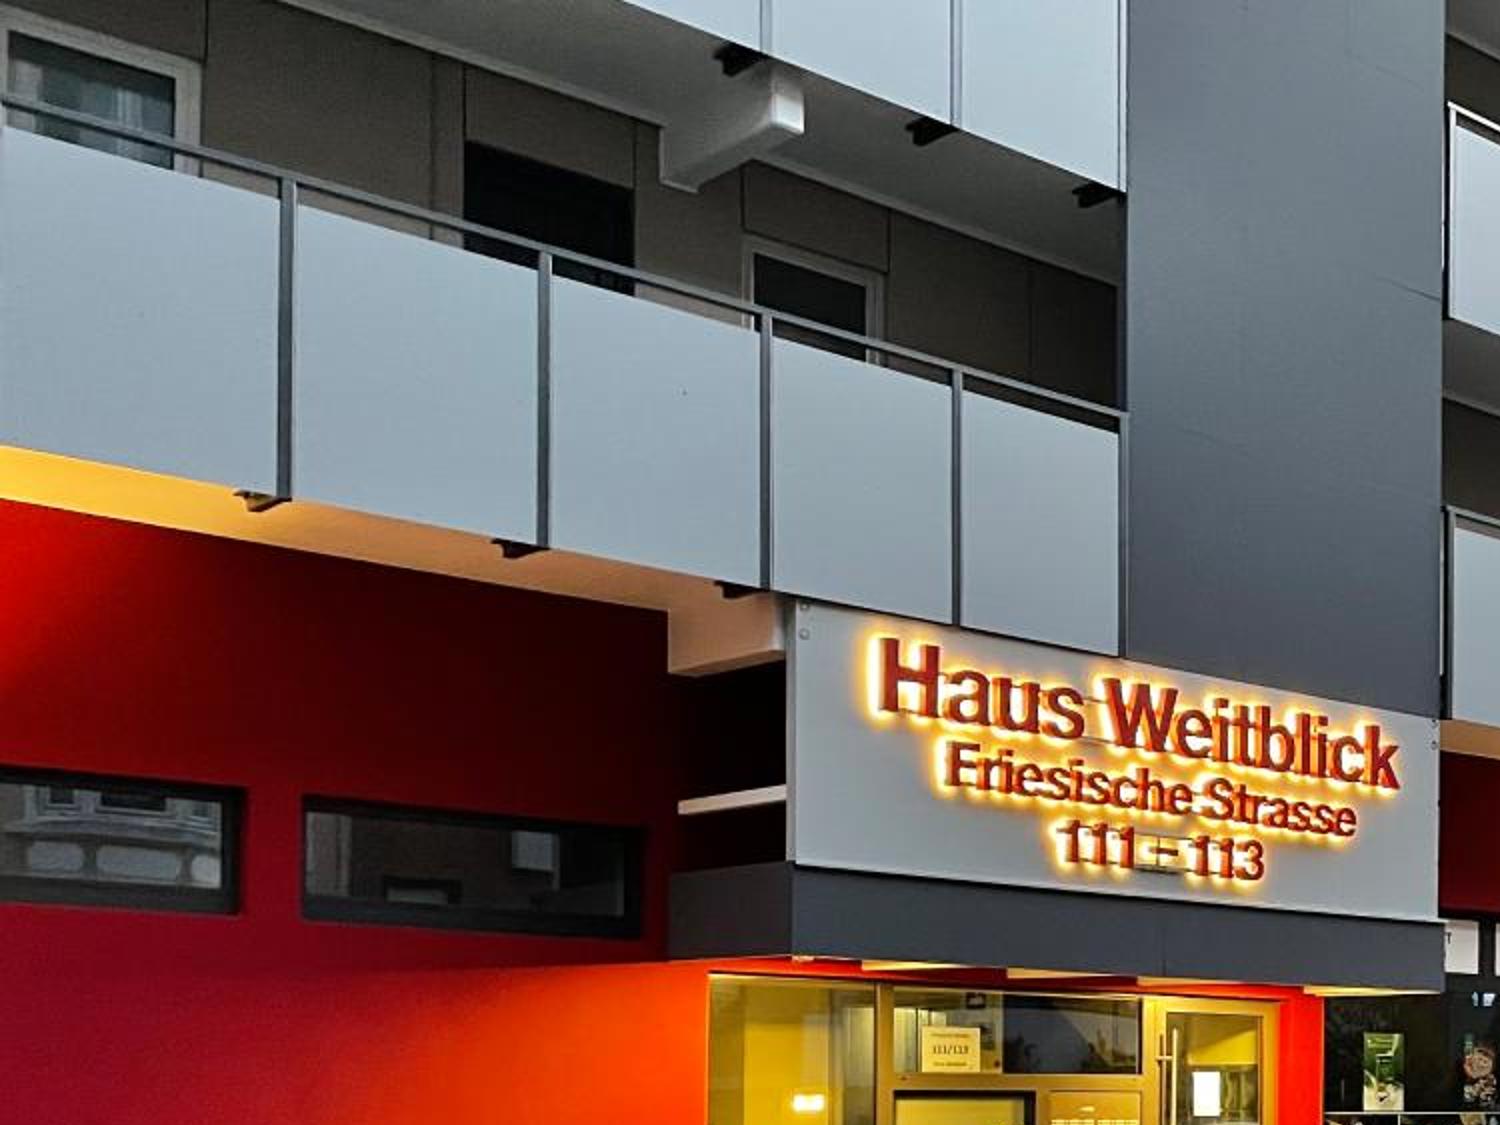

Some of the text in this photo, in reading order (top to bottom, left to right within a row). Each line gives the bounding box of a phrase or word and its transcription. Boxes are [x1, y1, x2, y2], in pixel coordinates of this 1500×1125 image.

[879, 637, 1400, 789] Haus Weitblick
[944, 740, 1357, 837] Friesische Strasse
[1056, 819, 1135, 869] 111
[1188, 835, 1265, 880] 113
